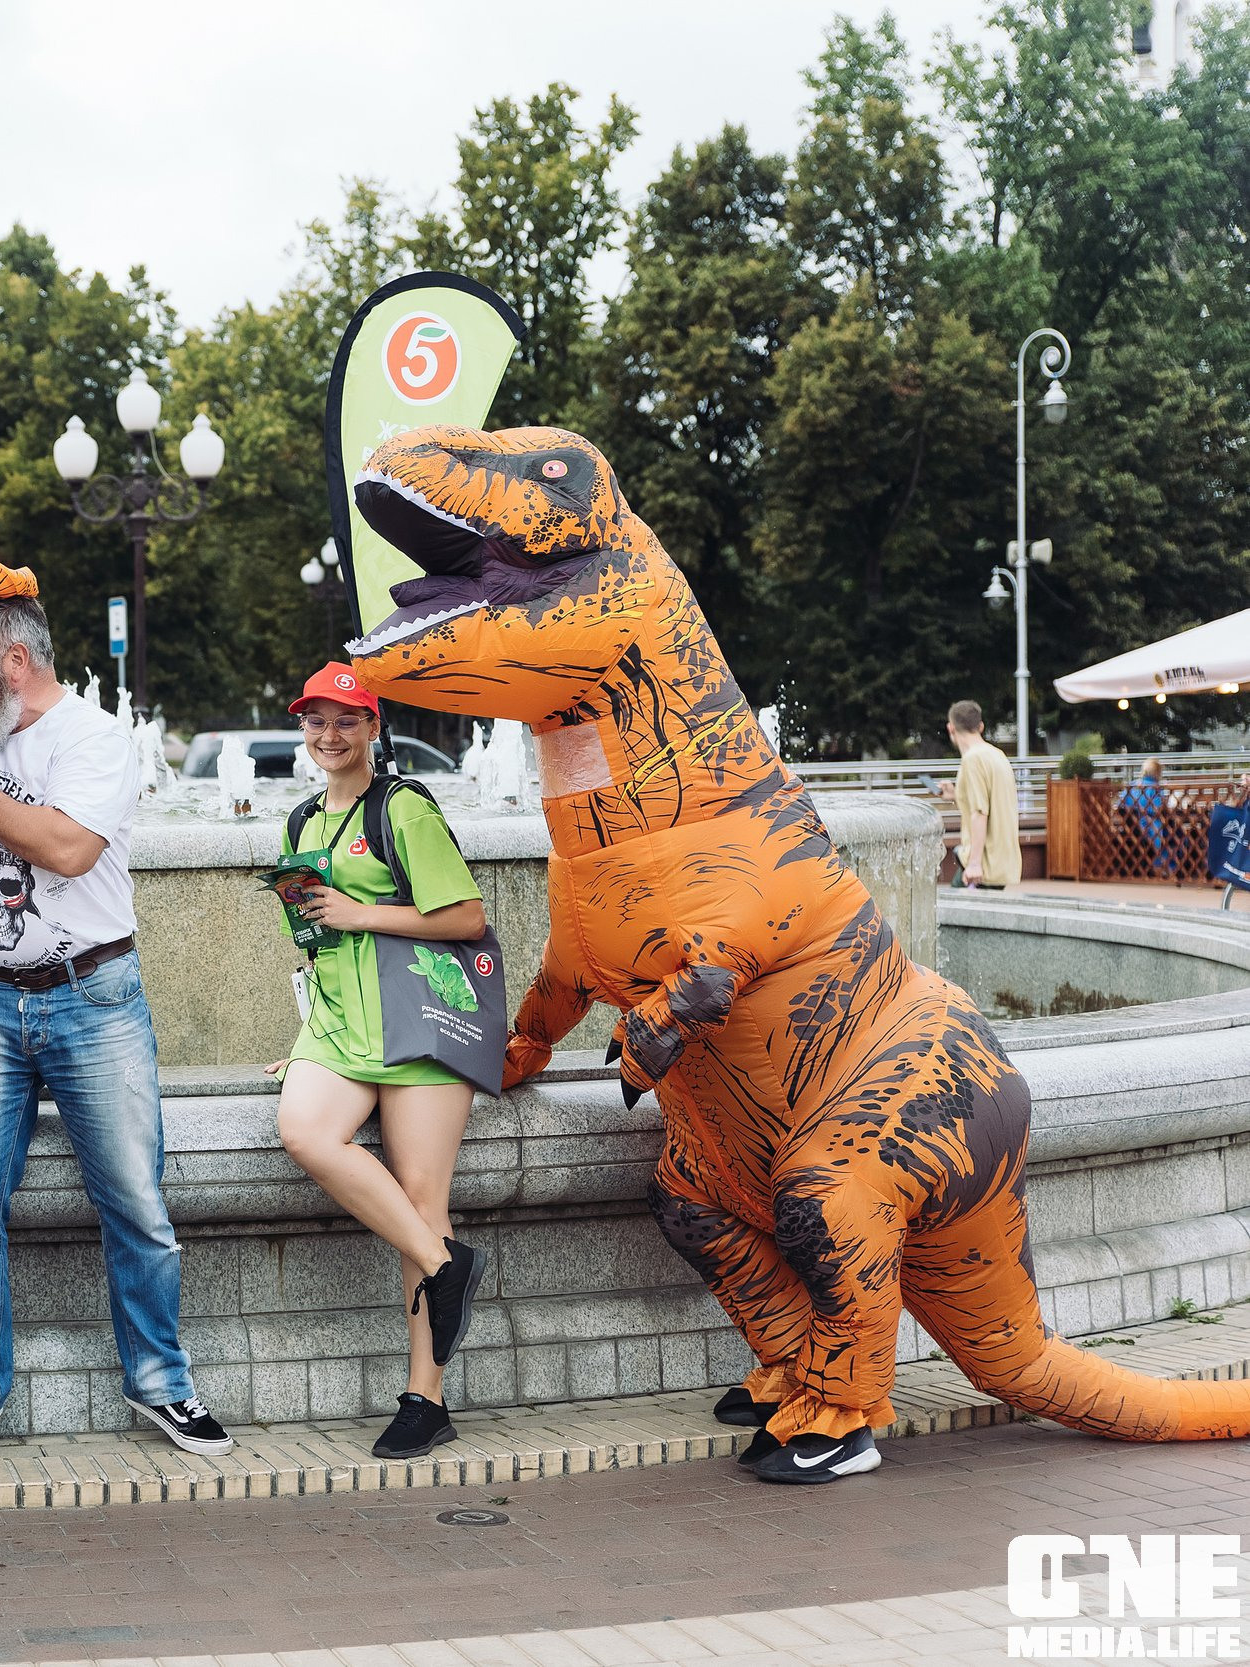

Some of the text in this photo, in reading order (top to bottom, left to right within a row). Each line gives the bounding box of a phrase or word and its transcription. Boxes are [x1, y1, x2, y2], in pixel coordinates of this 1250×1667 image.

[401, 322, 448, 387] 5
[422, 1013, 450, 1025] любовь
[455, 1024, 483, 1041] природе
